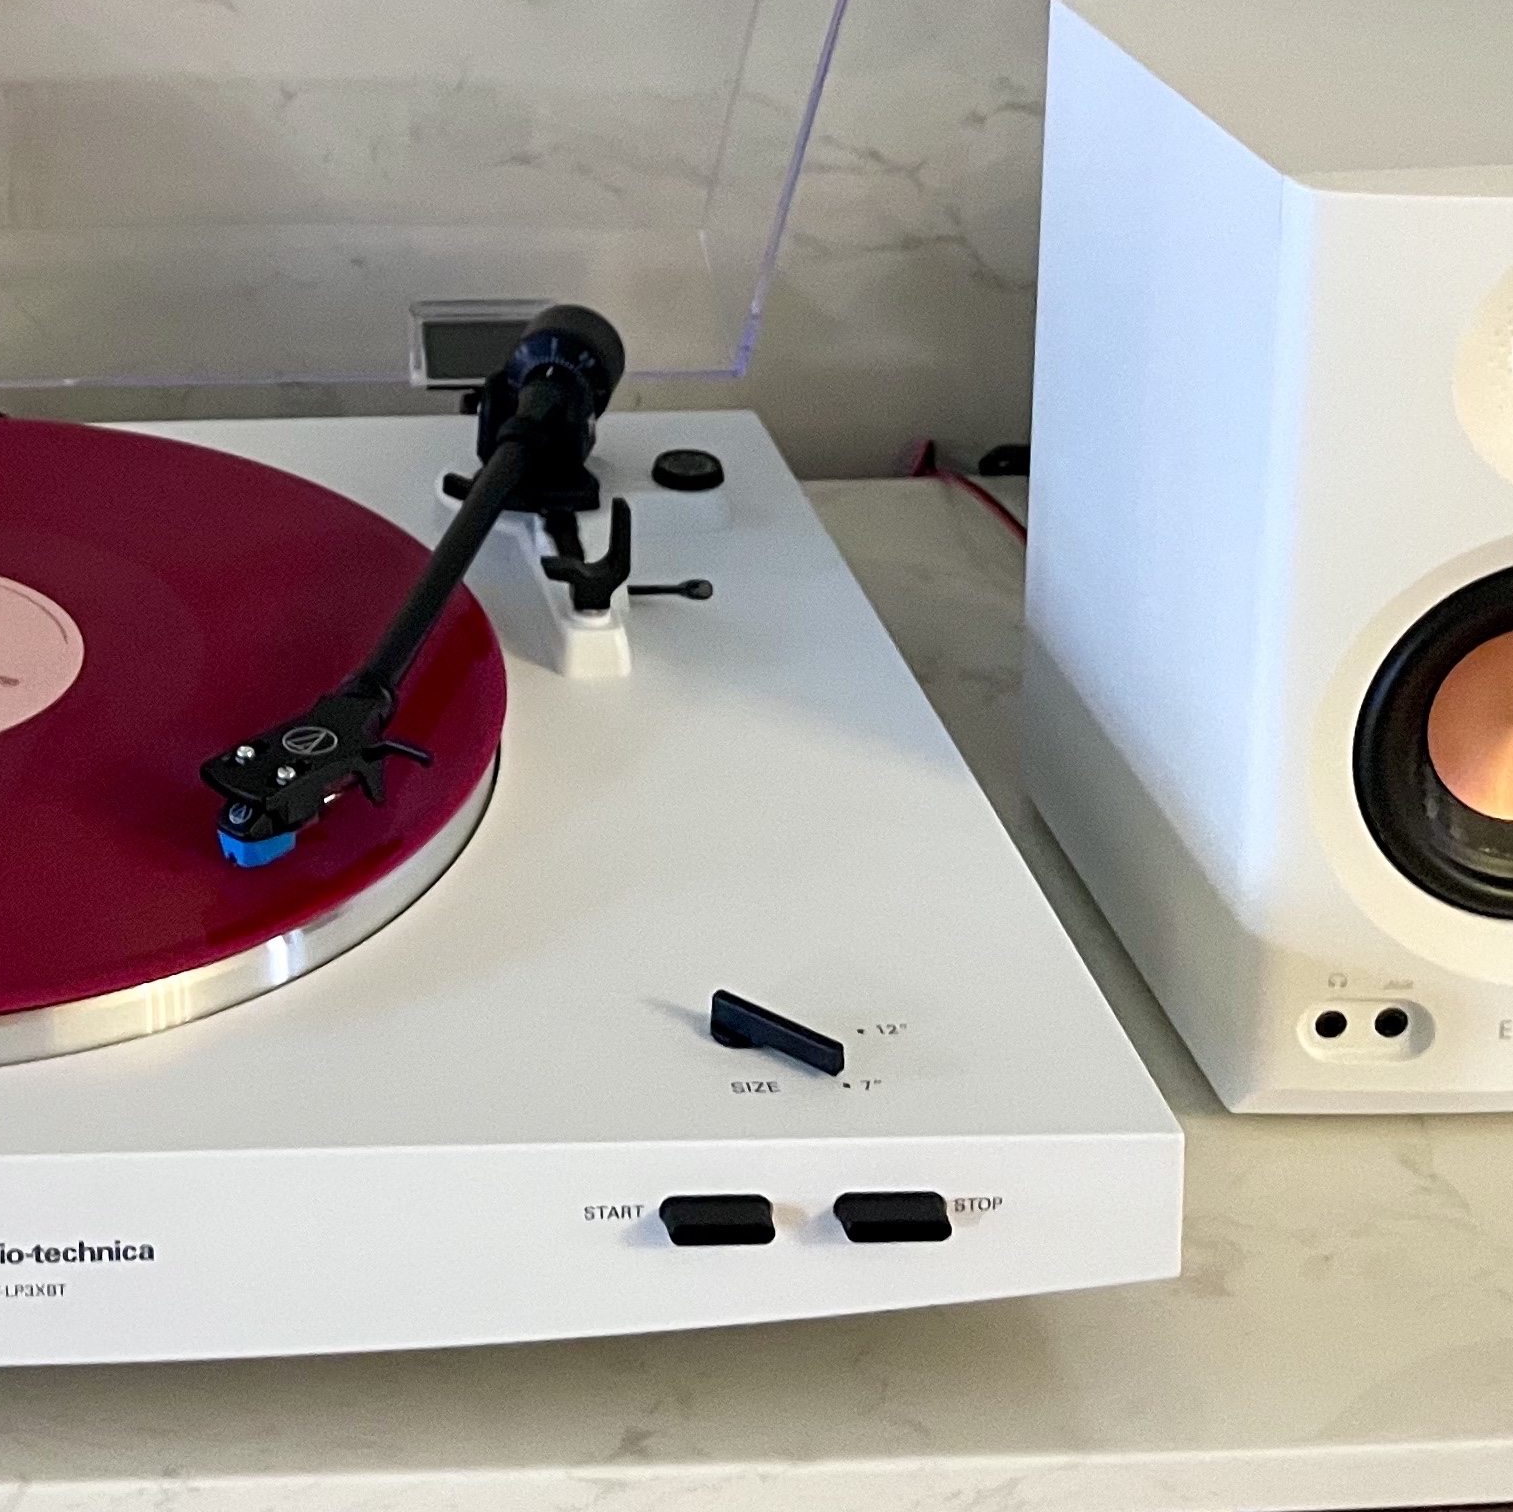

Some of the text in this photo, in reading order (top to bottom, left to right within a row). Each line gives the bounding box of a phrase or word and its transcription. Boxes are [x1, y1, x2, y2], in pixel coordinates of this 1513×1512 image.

[730, 1080, 781, 1095] SIZE
[584, 1204, 645, 1221] START
[954, 1196, 1004, 1213] STOP
